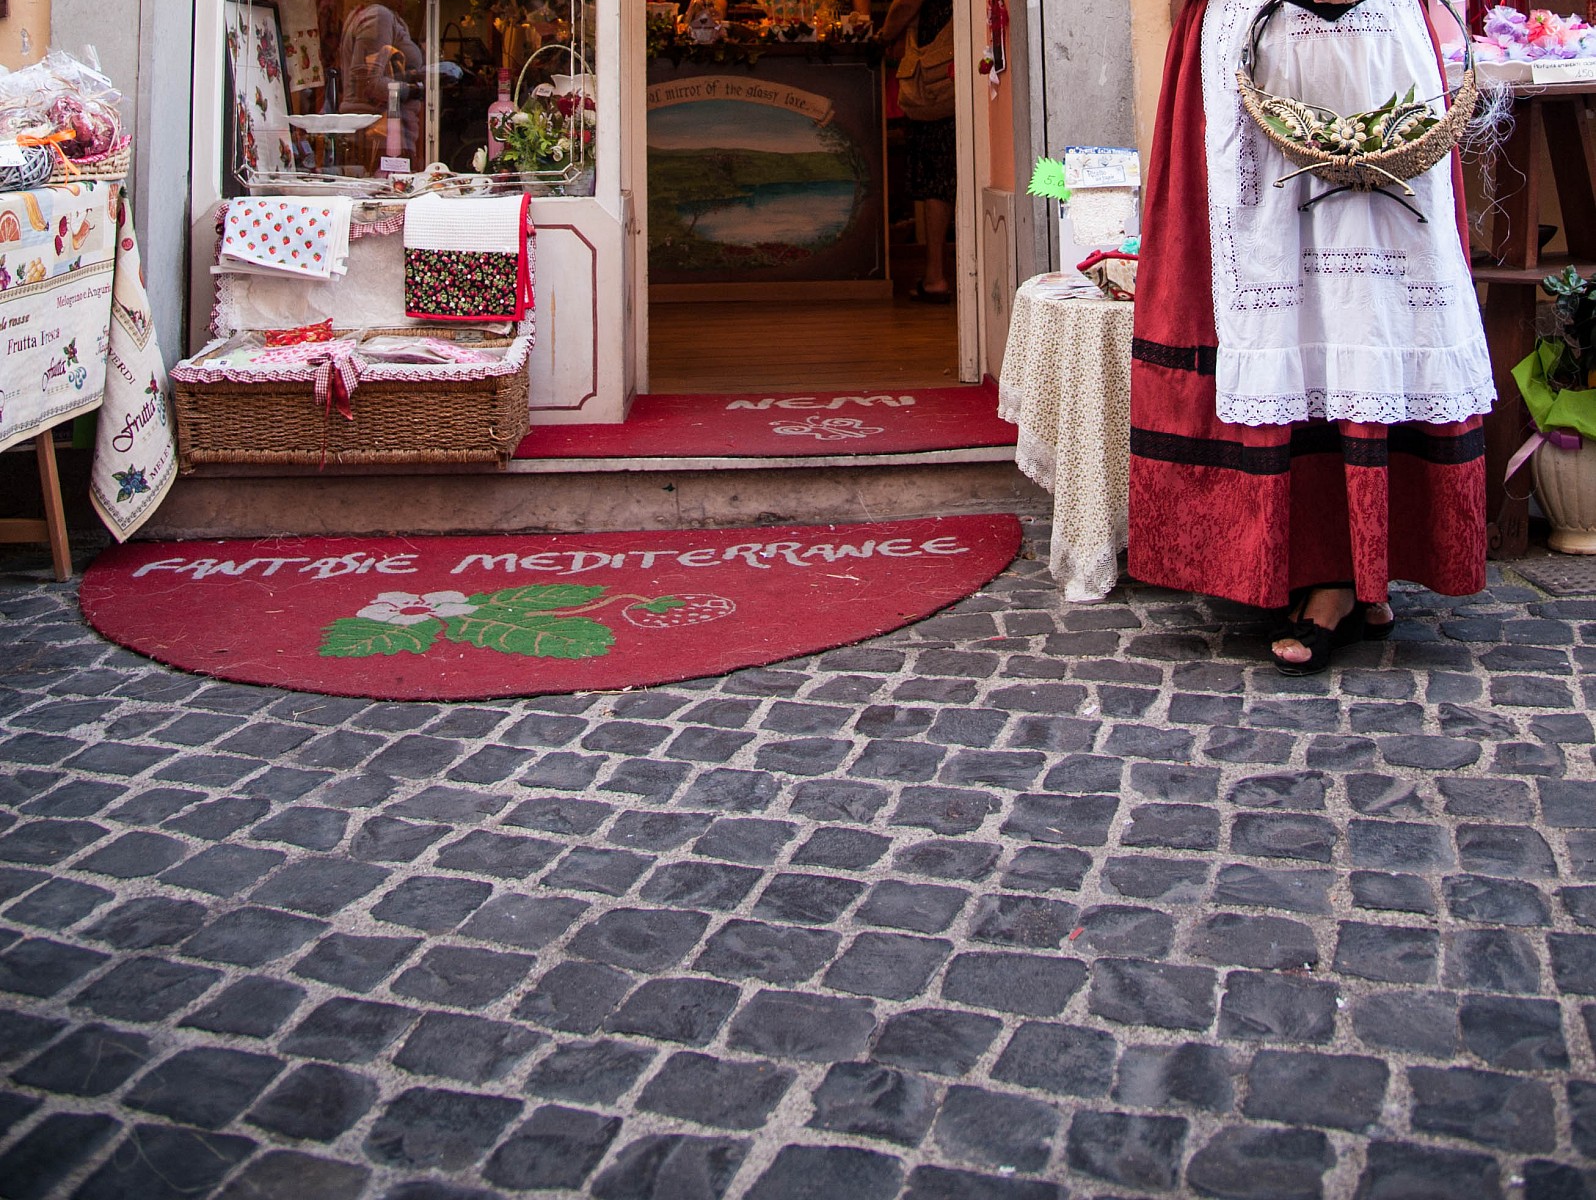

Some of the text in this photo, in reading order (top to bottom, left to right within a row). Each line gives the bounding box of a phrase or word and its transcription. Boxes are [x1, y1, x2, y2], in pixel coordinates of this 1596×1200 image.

[665, 84, 702, 101] mirror
[705, 79, 720, 97] of
[7, 335, 37, 355] Frutta
[107, 346, 136, 385] VERDI
[725, 395, 916, 410] NEMI
[112, 397, 156, 453] frutta
[132, 536, 970, 580] FANTASIE MEDITERRANEE
